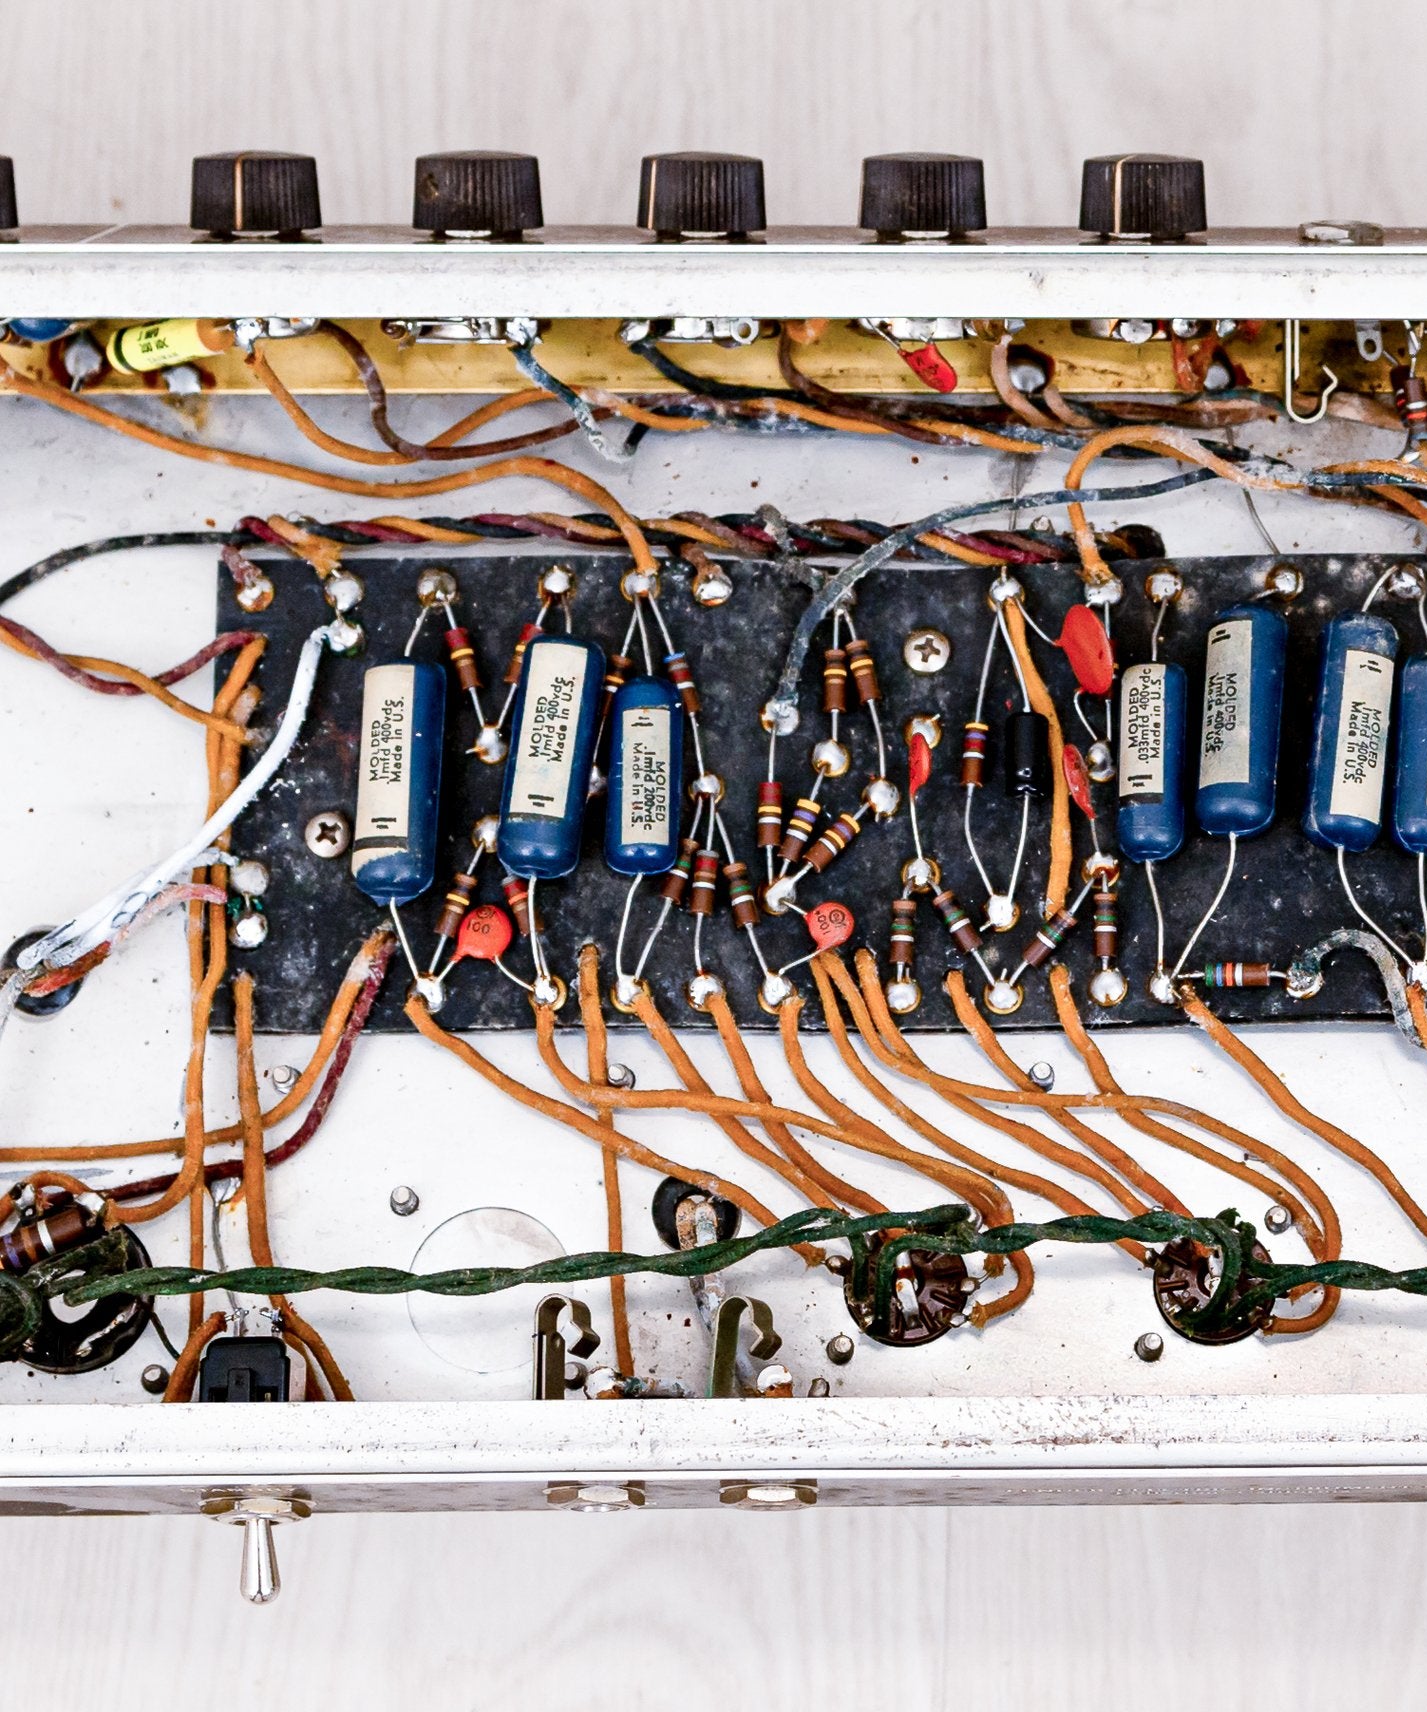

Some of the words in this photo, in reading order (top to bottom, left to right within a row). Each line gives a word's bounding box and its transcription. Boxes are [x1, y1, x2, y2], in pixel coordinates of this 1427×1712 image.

[393, 696, 404, 722] U.S.
[547, 677, 564, 720] 400vdc
[1138, 668, 1151, 710] 400vdc
[1224, 673, 1237, 731] MOLDED
[381, 700, 394, 743] 400vdc
[529, 697, 547, 757] MOLDED
[551, 725, 567, 762] Made
[561, 675, 574, 702] U.S.
[1128, 687, 1141, 748] MOLDED
[1153, 705, 1161, 716] in
[1213, 710, 1224, 752] 400vdc
[1348, 701, 1364, 736] Made
[370, 720, 380, 781] MOLDED
[1138, 715, 1149, 763] .033mfd
[1149, 722, 1161, 758] Made
[1368, 709, 1381, 768] MOLDED
[390, 745, 402, 782] Made
[632, 743, 643, 779] Made
[1343, 758, 1356, 784] U.S.
[1354, 742, 1369, 783] 400vdc
[644, 787, 655, 830] 200vdc
[655, 761, 666, 821] MOLDED
[631, 800, 643, 827] U.S.
[467, 919, 489, 933] 100
